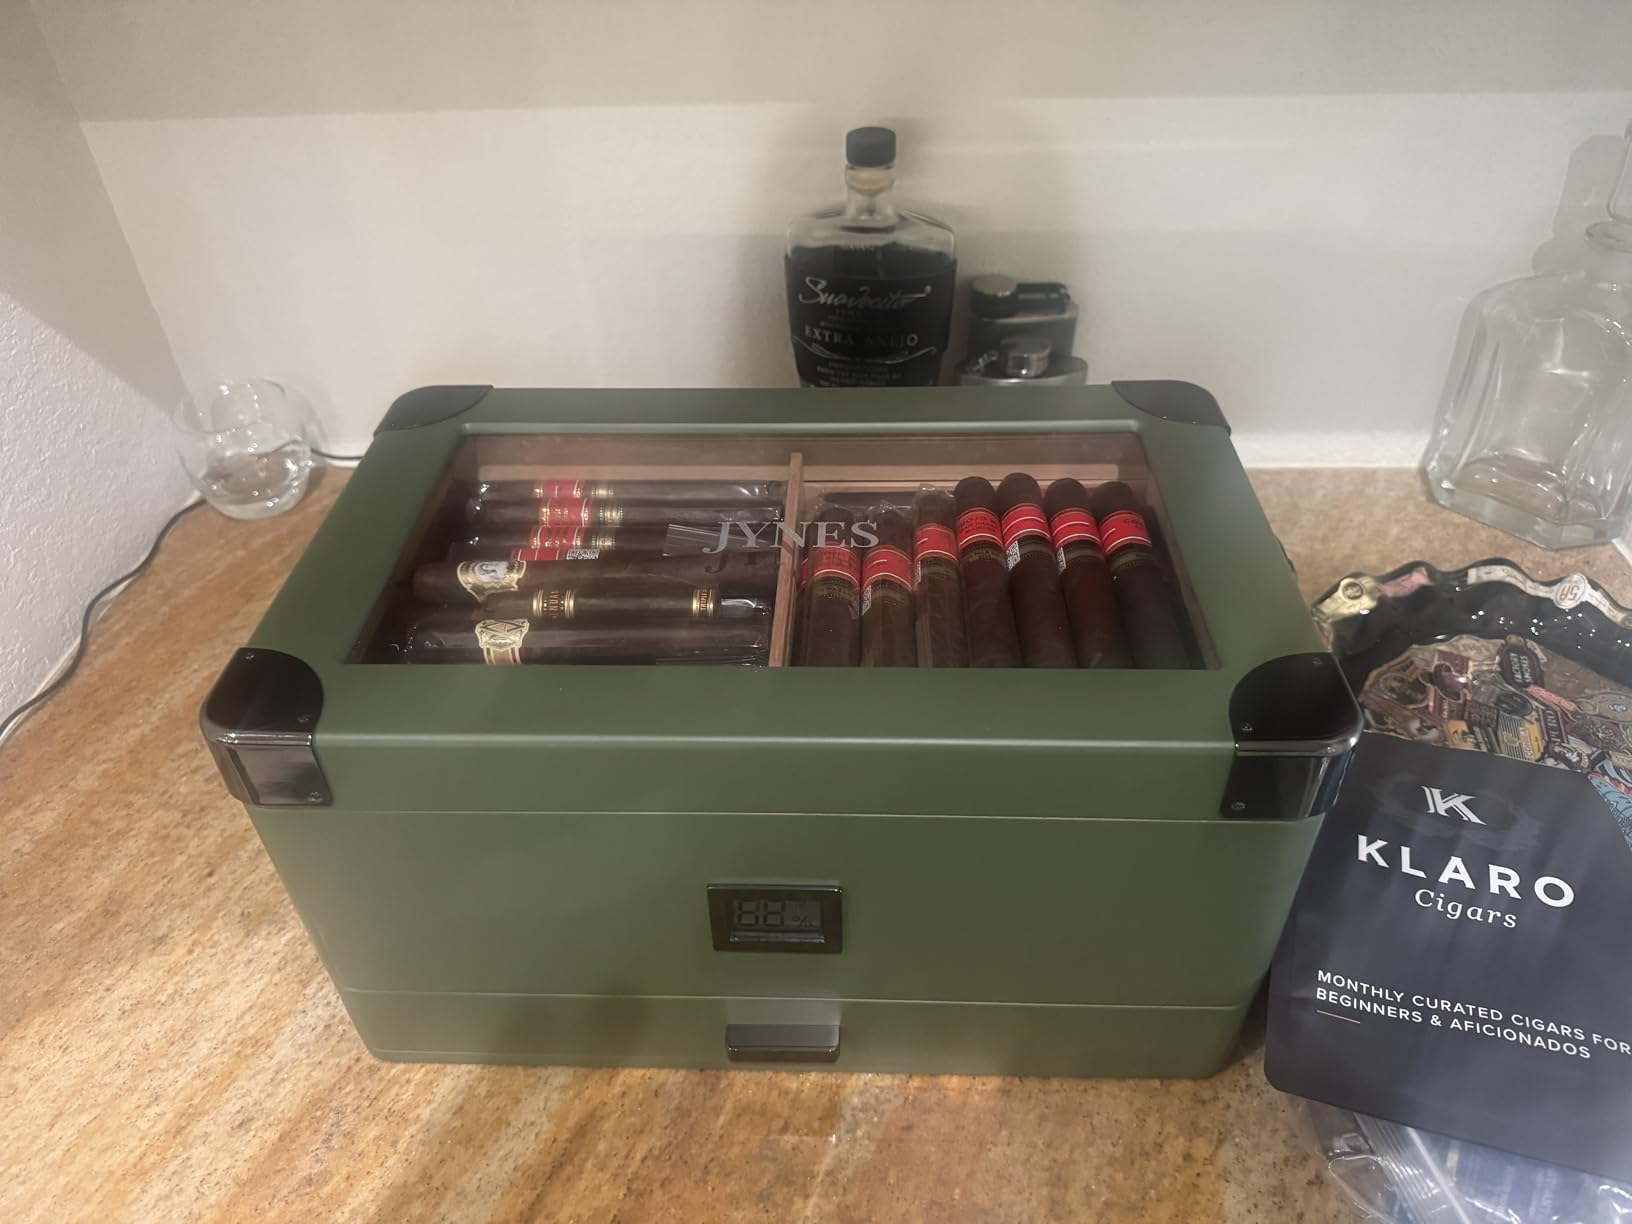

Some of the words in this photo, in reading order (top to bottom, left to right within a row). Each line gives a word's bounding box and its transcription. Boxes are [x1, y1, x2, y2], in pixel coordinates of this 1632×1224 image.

[804, 324, 854, 346] EXTRA
[702, 520, 880, 554] JYNES
[1357, 834, 1575, 908] KLARO
[1415, 889, 1517, 928] Cigars
[1316, 987, 1423, 1023] BEGINNERS
[1430, 1014, 1442, 1027] &
[1450, 1018, 1591, 1059] AFICIONADOS
[1317, 969, 1405, 1003] MONTHLY
[1412, 995, 1503, 1021] CURATED
[1511, 1014, 1585, 1041] CIGARS
[1592, 1033, 1631, 1056] FOR
